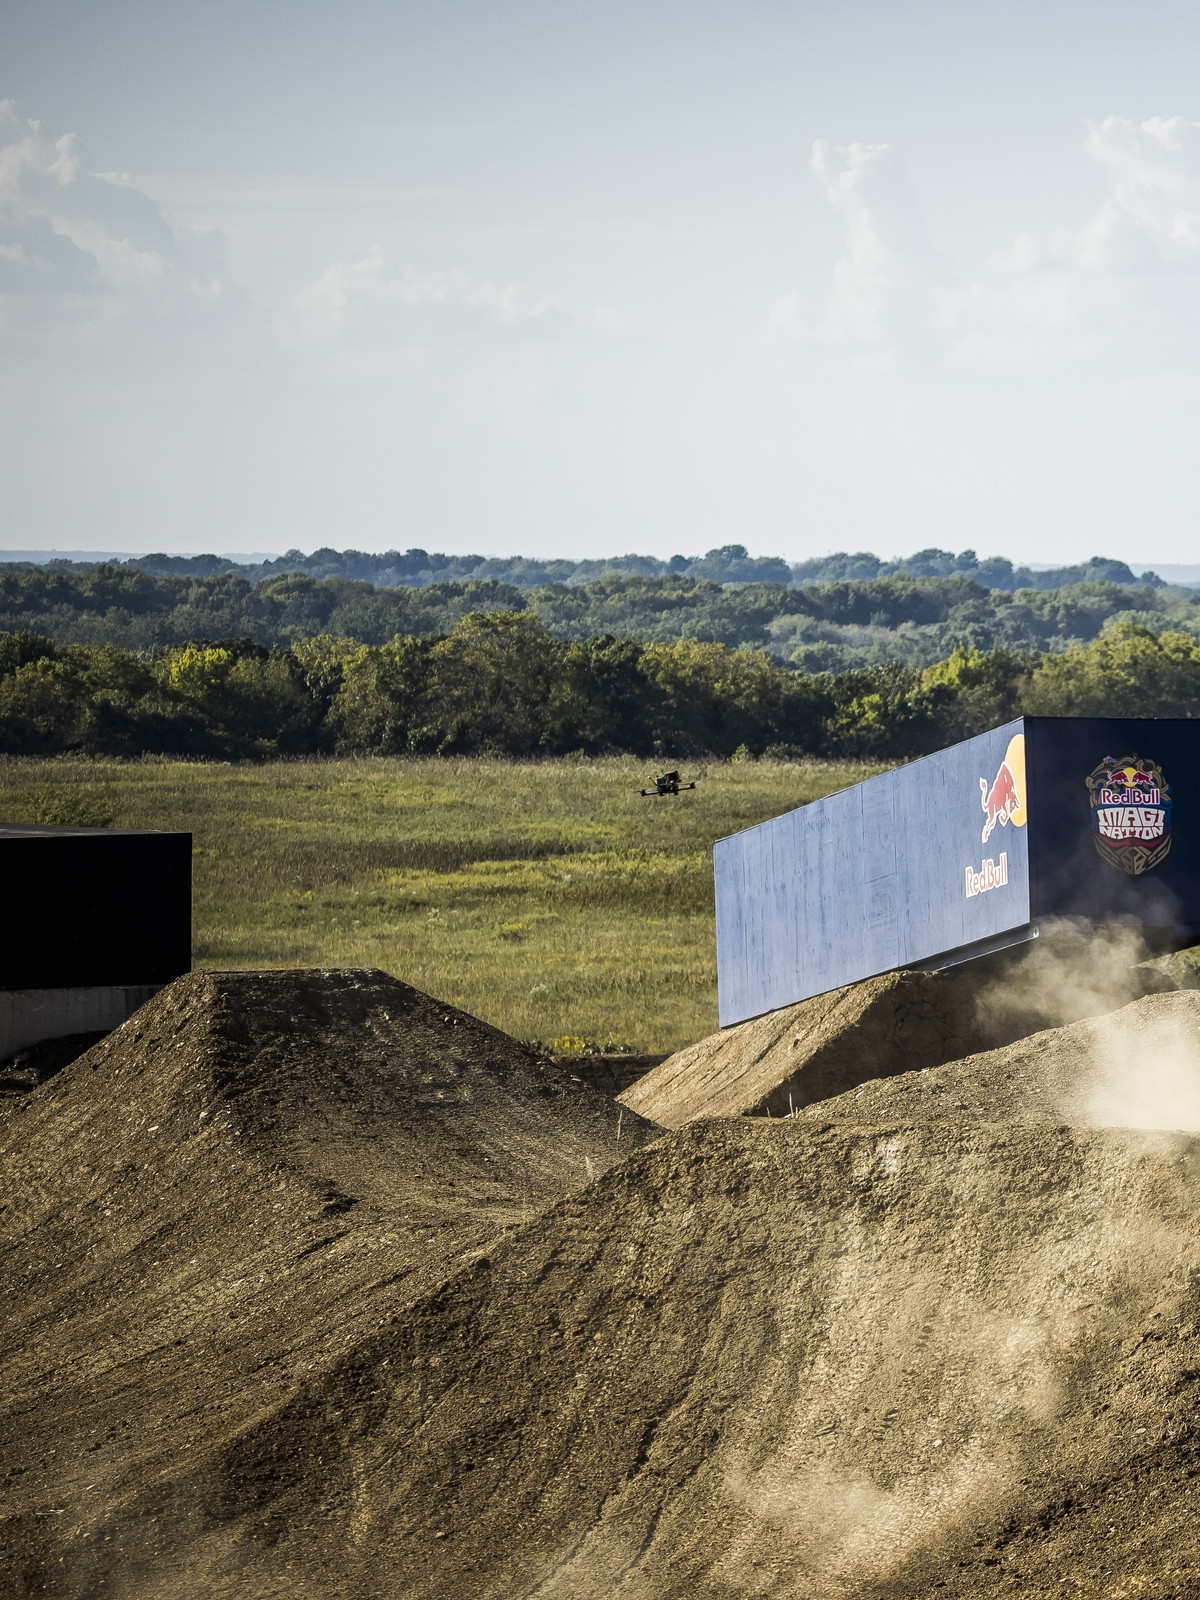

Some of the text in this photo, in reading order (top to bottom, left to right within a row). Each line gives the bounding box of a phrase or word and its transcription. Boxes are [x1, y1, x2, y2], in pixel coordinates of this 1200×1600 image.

[1101, 787, 1160, 805] Red Bull
[1097, 807, 1166, 827] IMAGI
[1099, 825, 1164, 840] NATION
[965, 852, 1008, 898] Red Bull
